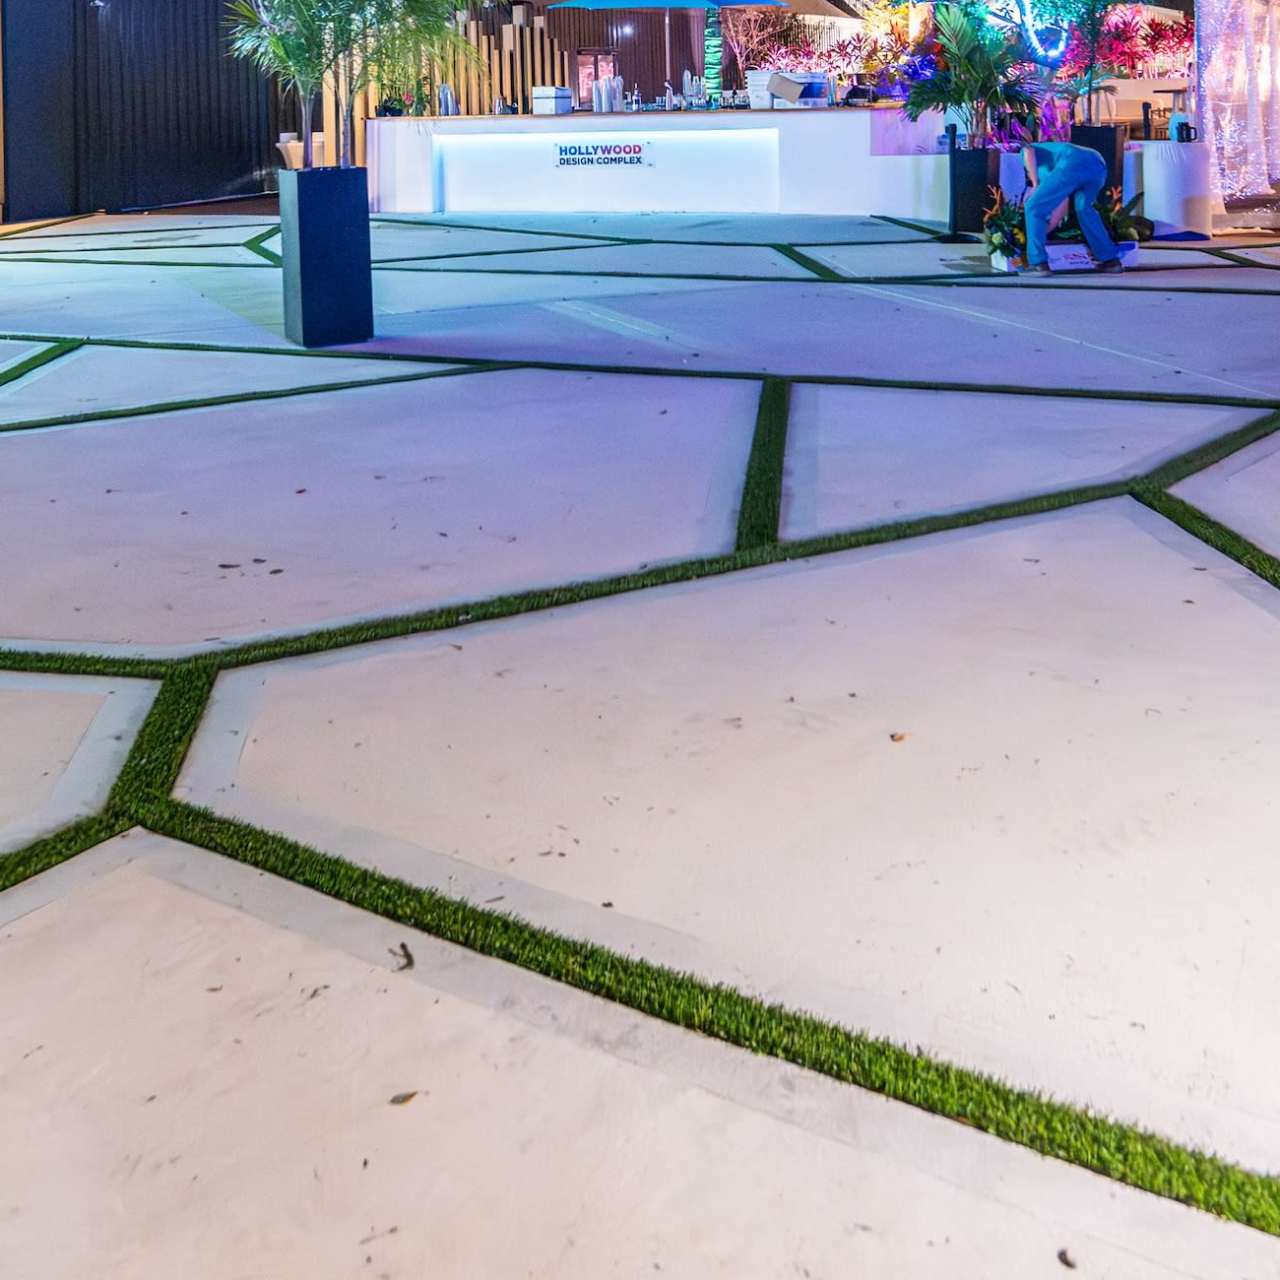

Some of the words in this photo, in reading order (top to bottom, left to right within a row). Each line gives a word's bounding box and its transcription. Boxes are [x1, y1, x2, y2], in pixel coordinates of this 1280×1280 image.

[559, 145, 642, 156] HOLLYWOOD
[559, 157, 594, 166] DESIGN
[596, 156, 642, 165] COMPLEX
